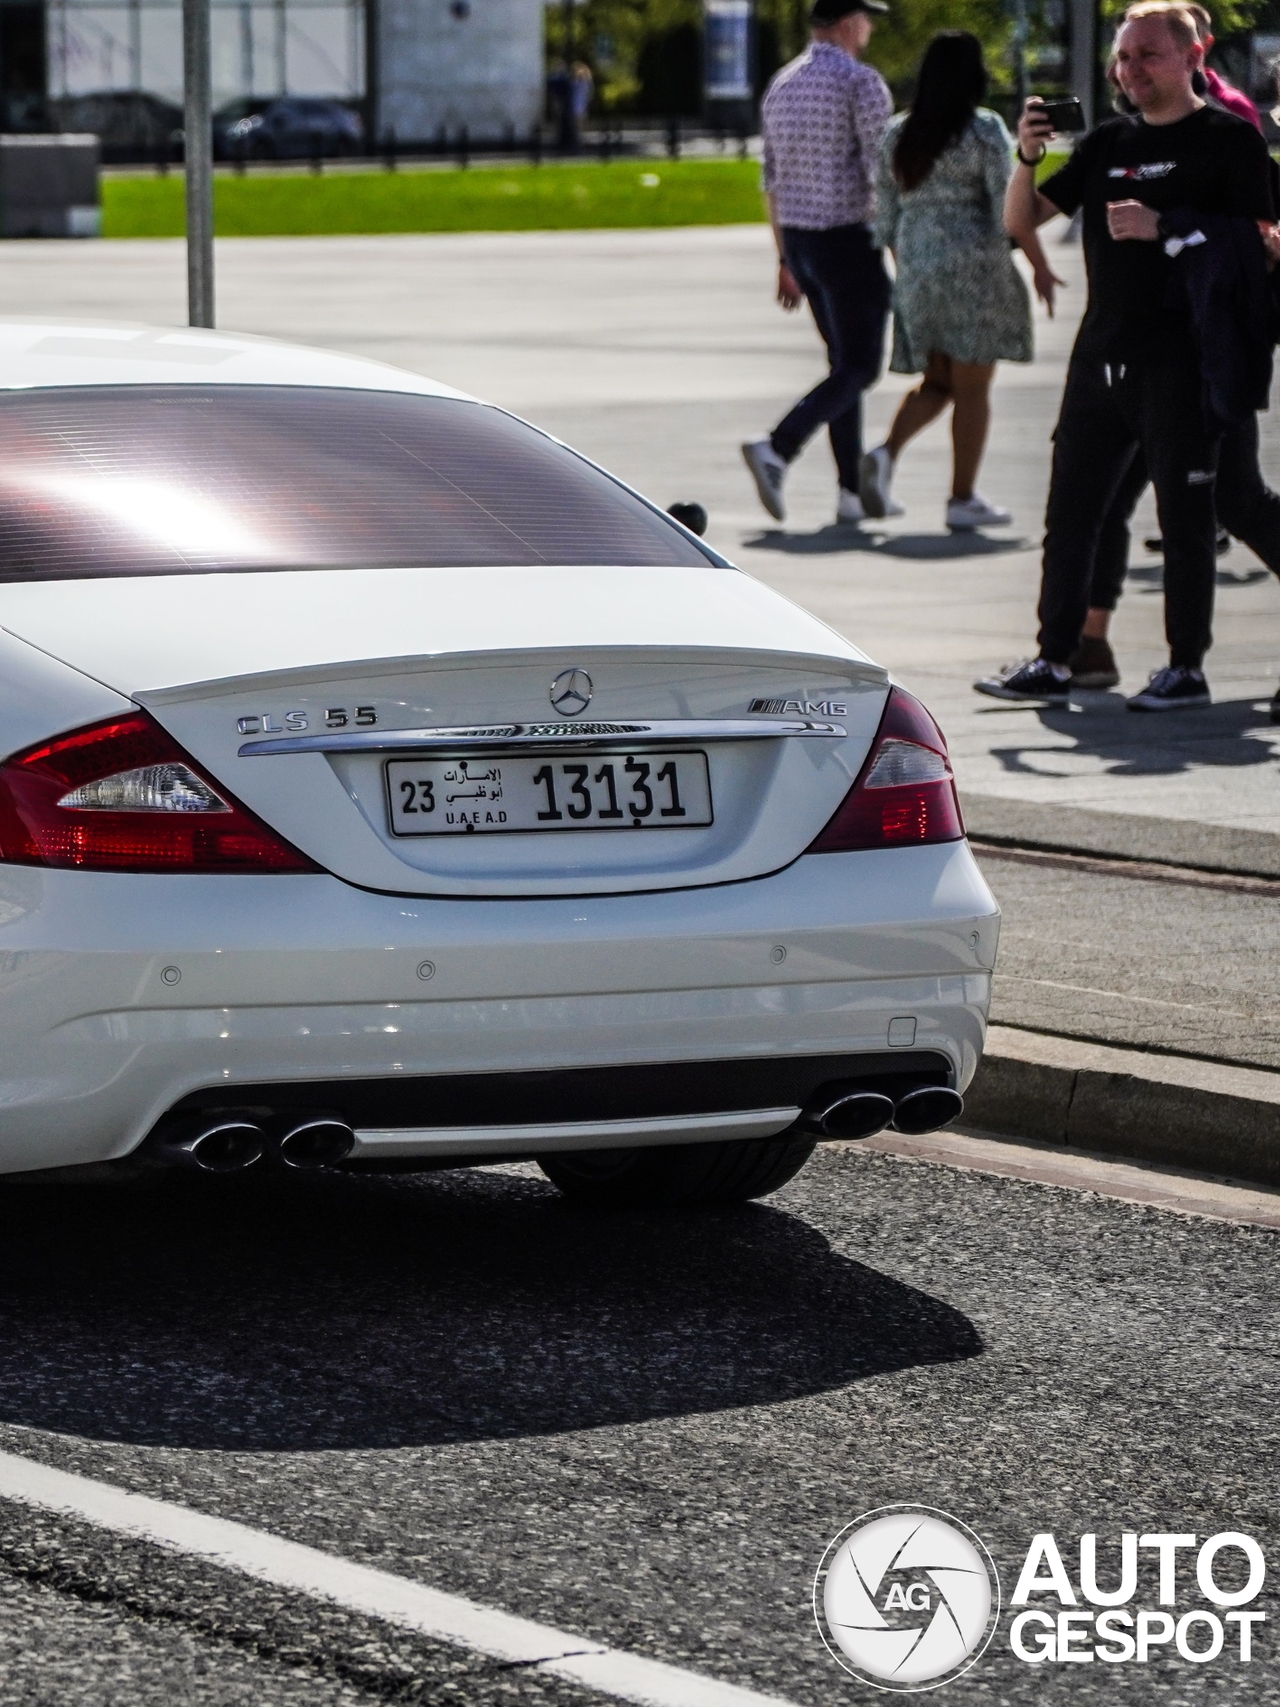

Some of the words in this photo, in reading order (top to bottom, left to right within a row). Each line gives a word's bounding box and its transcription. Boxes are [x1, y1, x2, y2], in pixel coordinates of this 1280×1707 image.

[237, 711, 309, 735] CLS
[324, 706, 379, 728] 55
[780, 700, 848, 717] AMG
[400, 781, 436, 814] 23
[533, 761, 687, 822] 13131
[485, 811, 508, 824] A.D
